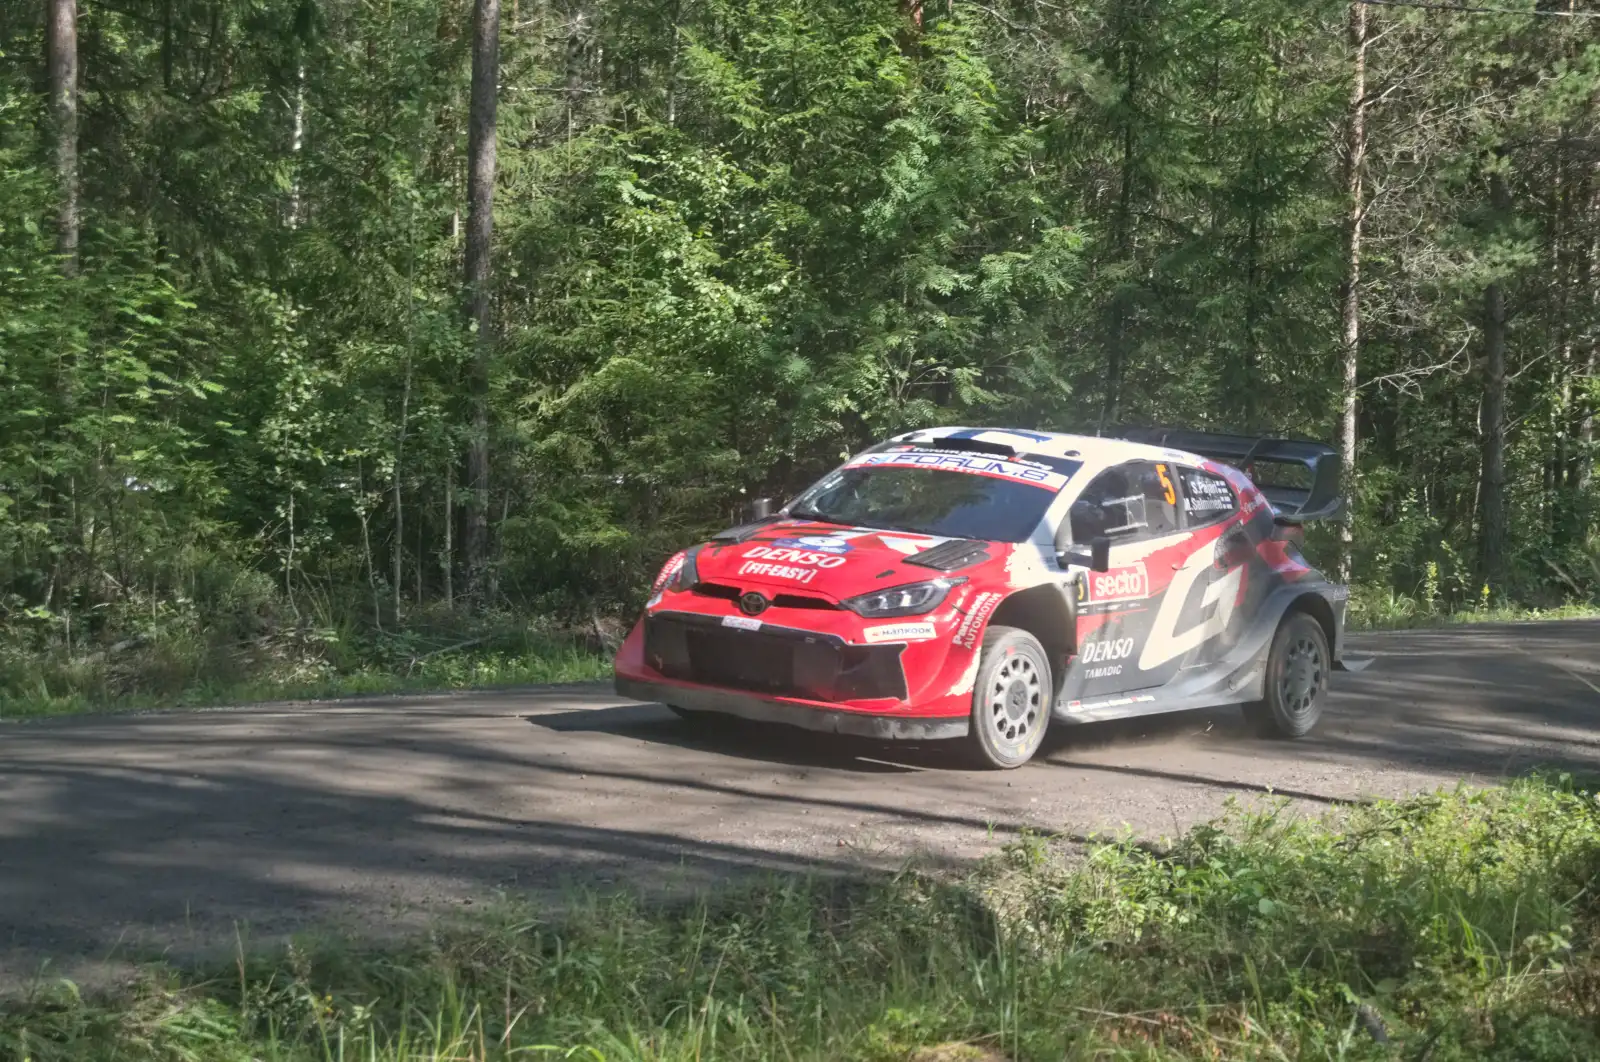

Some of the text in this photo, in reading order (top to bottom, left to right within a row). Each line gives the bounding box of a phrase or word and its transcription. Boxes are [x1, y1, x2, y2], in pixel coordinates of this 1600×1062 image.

[1155, 464, 1177, 506] 5
[741, 546, 847, 569] DENSO
[1081, 637, 1134, 664] DENSO
[1083, 664, 1123, 680] TAMADIC
